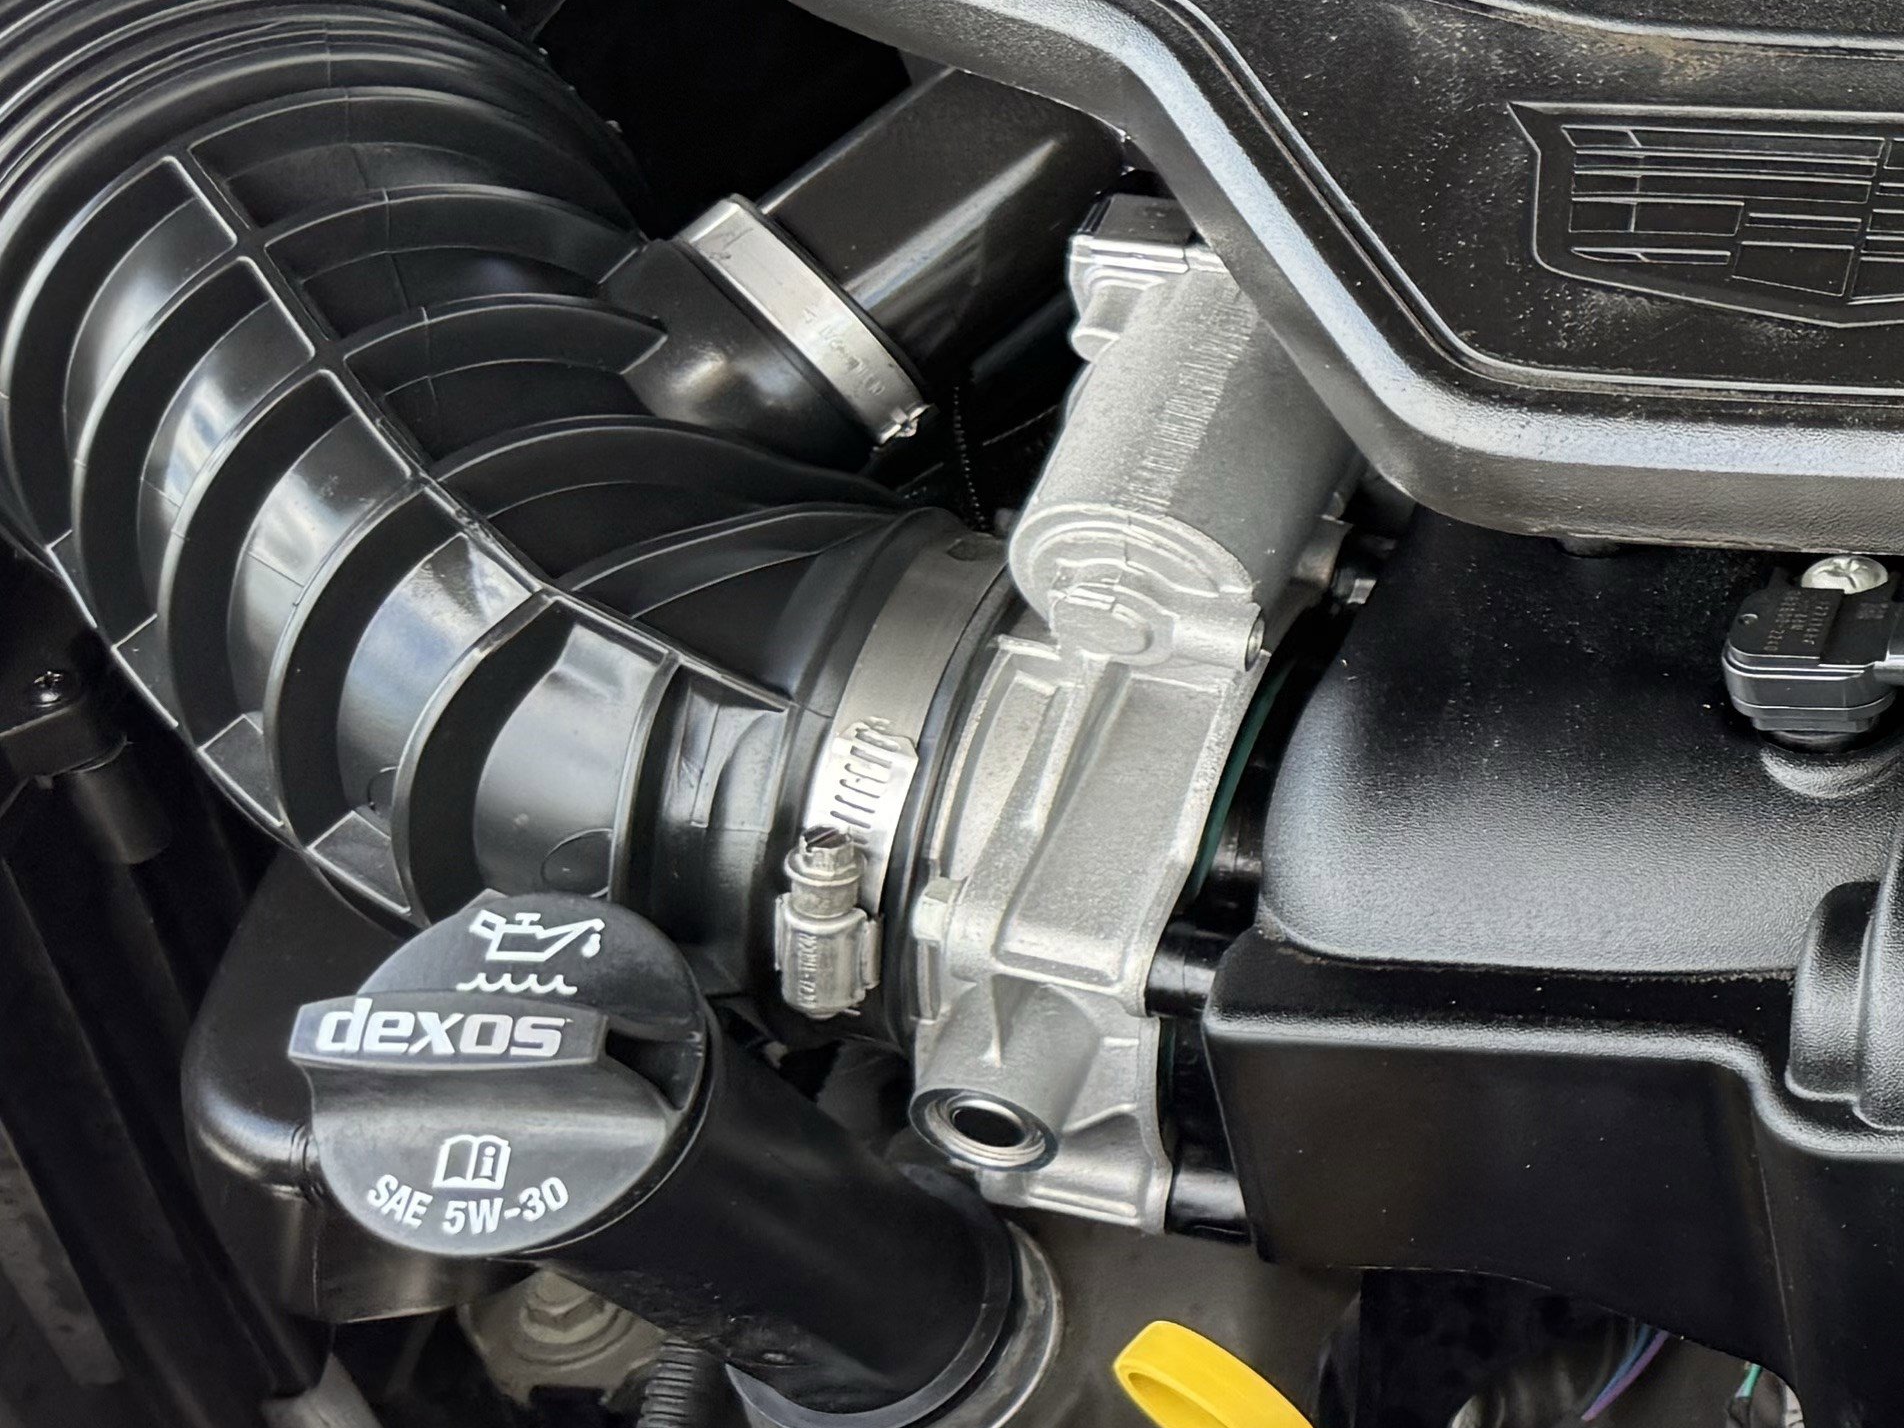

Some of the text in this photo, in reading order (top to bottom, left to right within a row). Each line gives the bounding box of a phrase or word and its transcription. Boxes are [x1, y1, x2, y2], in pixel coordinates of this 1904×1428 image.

[315, 998, 567, 1058] dexos
[367, 1175, 570, 1235] SAE 5W-30
